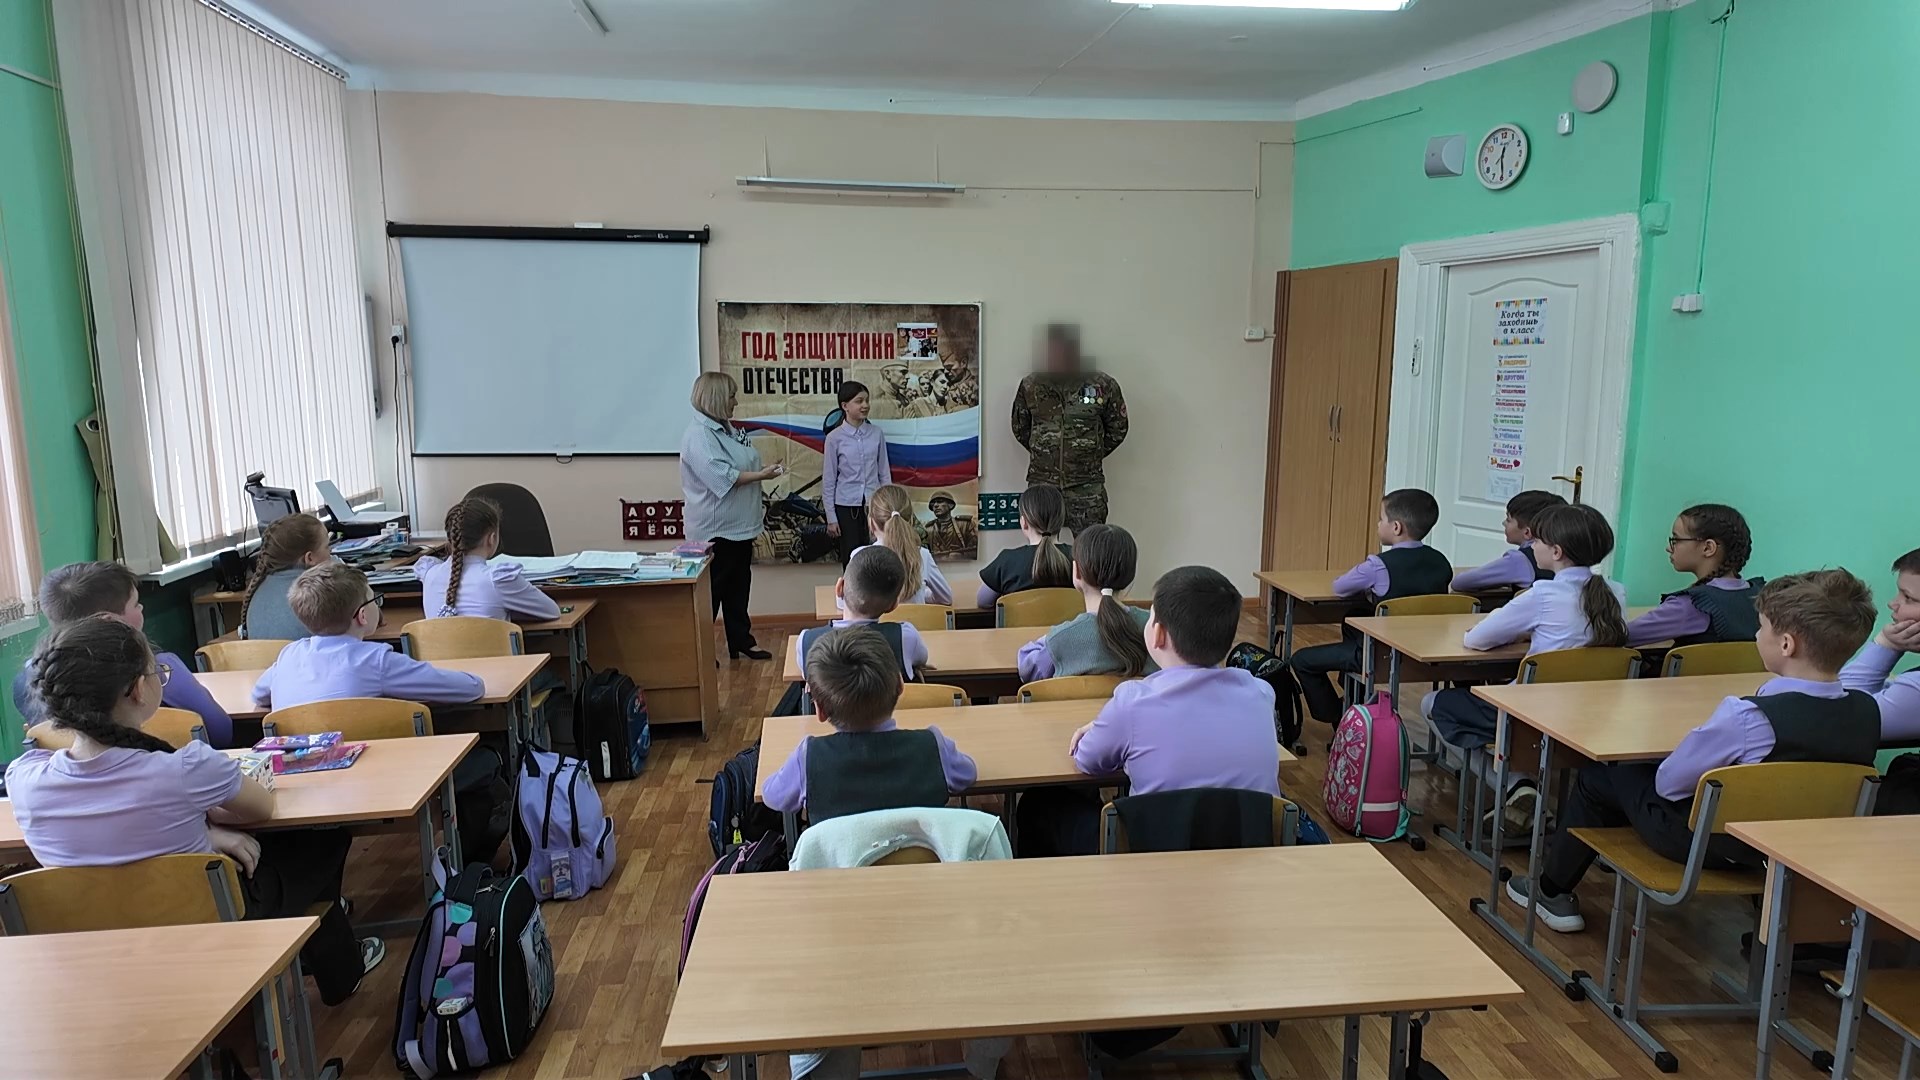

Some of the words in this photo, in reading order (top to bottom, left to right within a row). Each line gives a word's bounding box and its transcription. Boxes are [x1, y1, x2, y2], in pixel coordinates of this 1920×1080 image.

[1501, 131, 1508, 139] 12
[1500, 309, 1524, 318] Когда
[1498, 318, 1538, 326] заходишь
[741, 332, 778, 361] ГОД
[783, 332, 894, 361] ЗАЩИТНИКА
[743, 368, 844, 394] ОТЕЧЕСТВА
[989, 500, 996, 509] 2
[1000, 500, 1006, 508] 3
[1011, 499, 1018, 508] 4
[628, 507, 637, 517] А
[646, 506, 656, 516] О
[665, 506, 673, 516] У
[629, 526, 638, 536] Я
[648, 524, 656, 535] Ё
[664, 525, 676, 535] Ю
